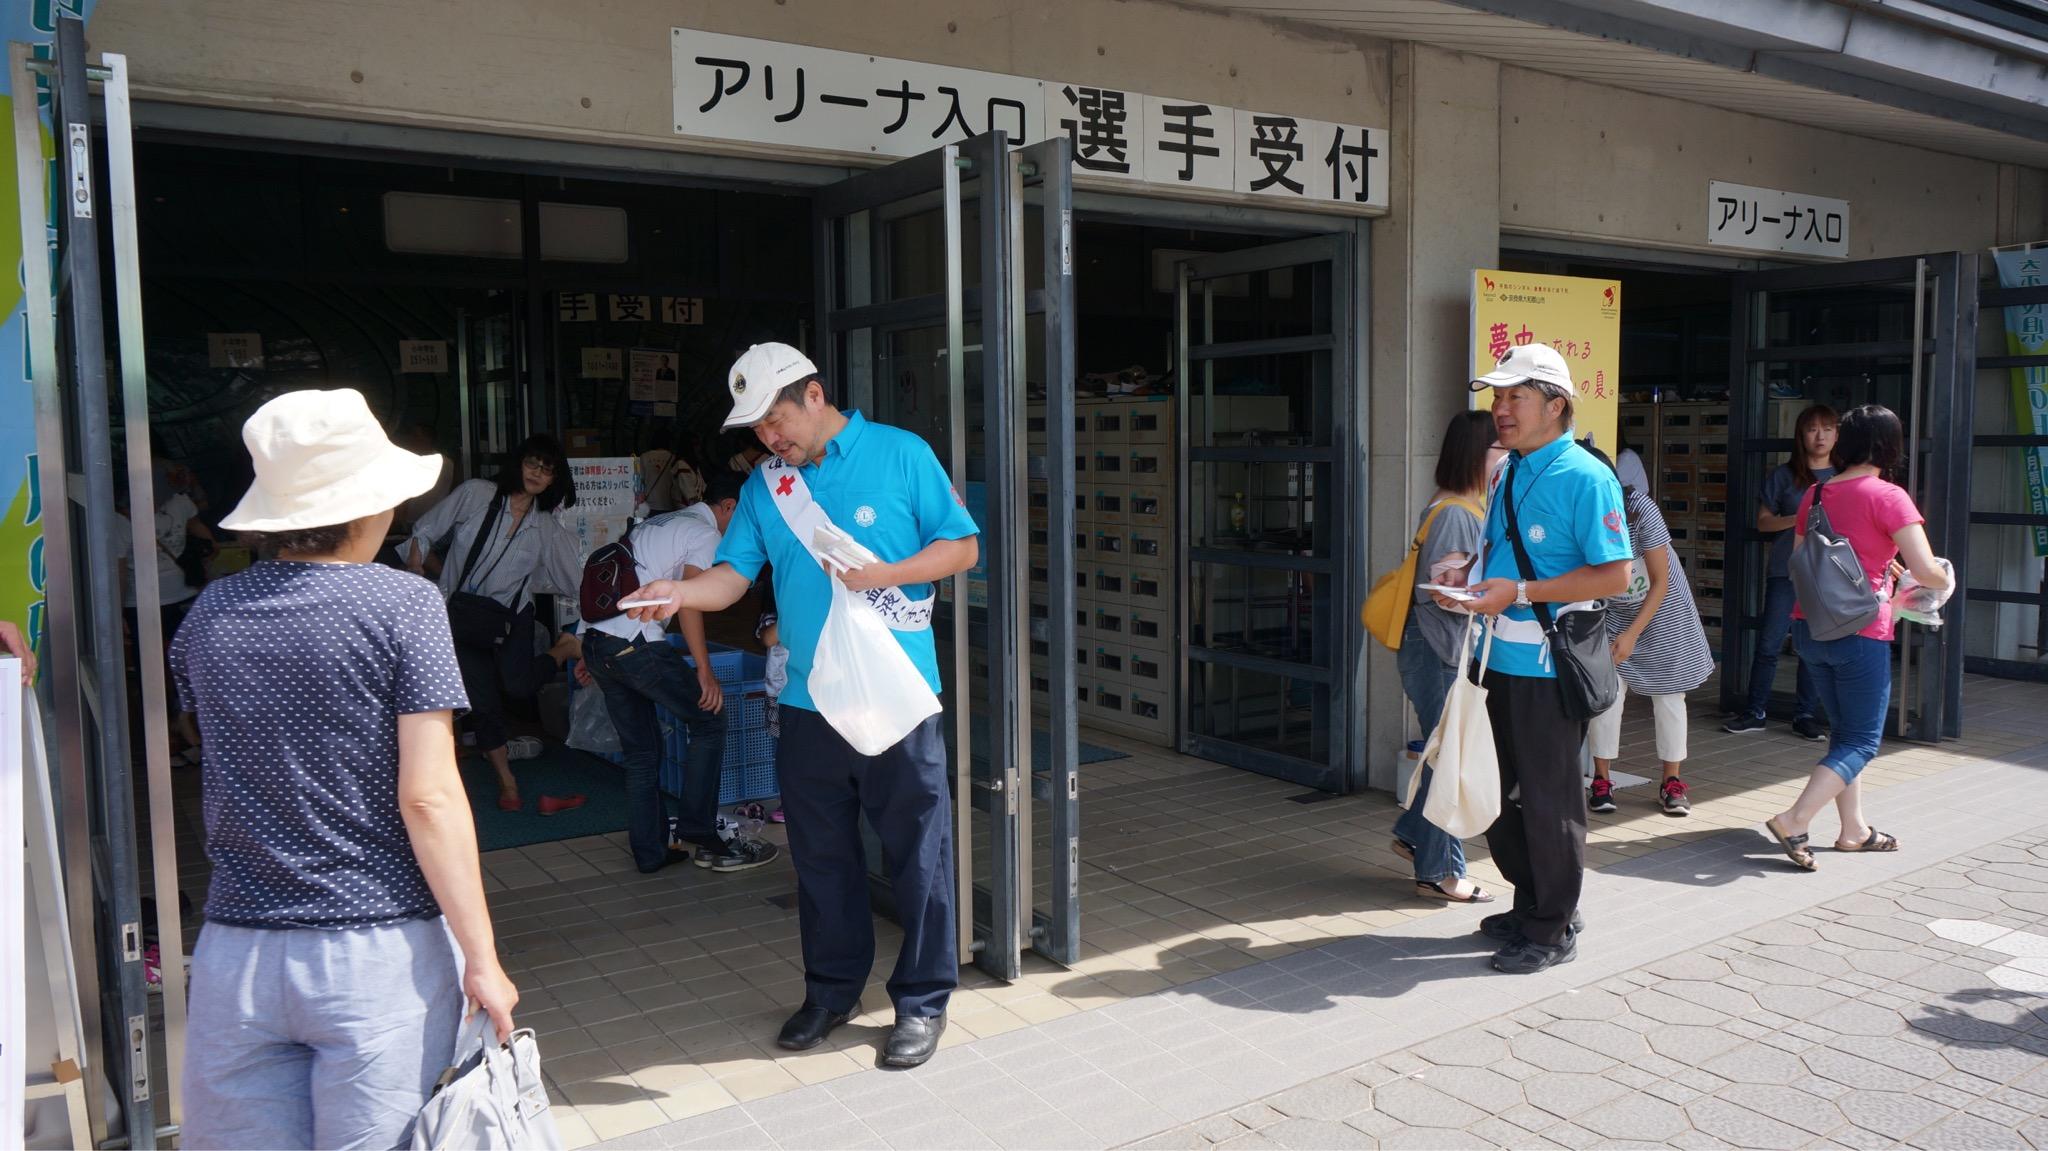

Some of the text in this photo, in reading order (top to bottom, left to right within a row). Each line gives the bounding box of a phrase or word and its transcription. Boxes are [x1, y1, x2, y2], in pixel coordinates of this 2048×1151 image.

[695, 56, 1379, 203] アリーナ入口 選手受付
[1717, 197, 1842, 244] アリーナ入口
